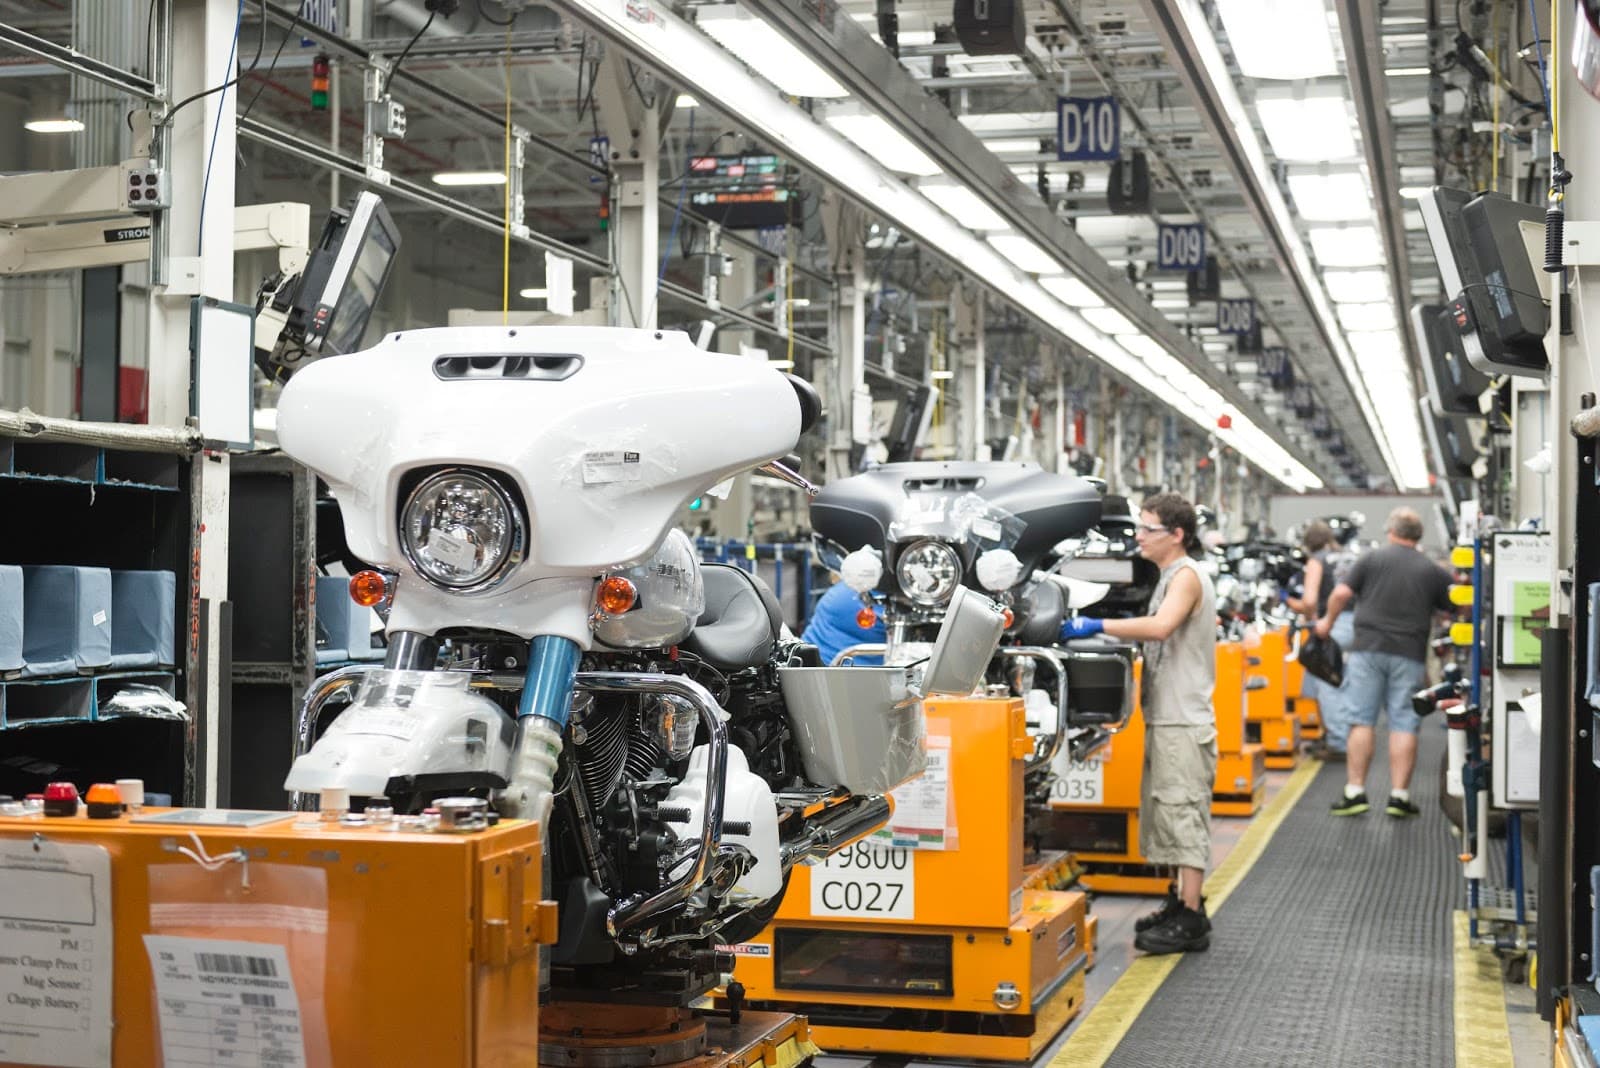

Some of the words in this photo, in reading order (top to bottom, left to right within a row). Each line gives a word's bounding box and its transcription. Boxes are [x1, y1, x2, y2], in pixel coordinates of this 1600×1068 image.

[1062, 103, 1114, 153] D10
[1161, 228, 1200, 265] D09
[1050, 779, 1097, 799] 035
[821, 880, 904, 912] C027
[60, 938, 79, 951] PM
[23, 974, 46, 990] Mag
[47, 976, 81, 990] Sensor
[7, 992, 42, 1009] Charge
[44, 995, 79, 1012] Battery
